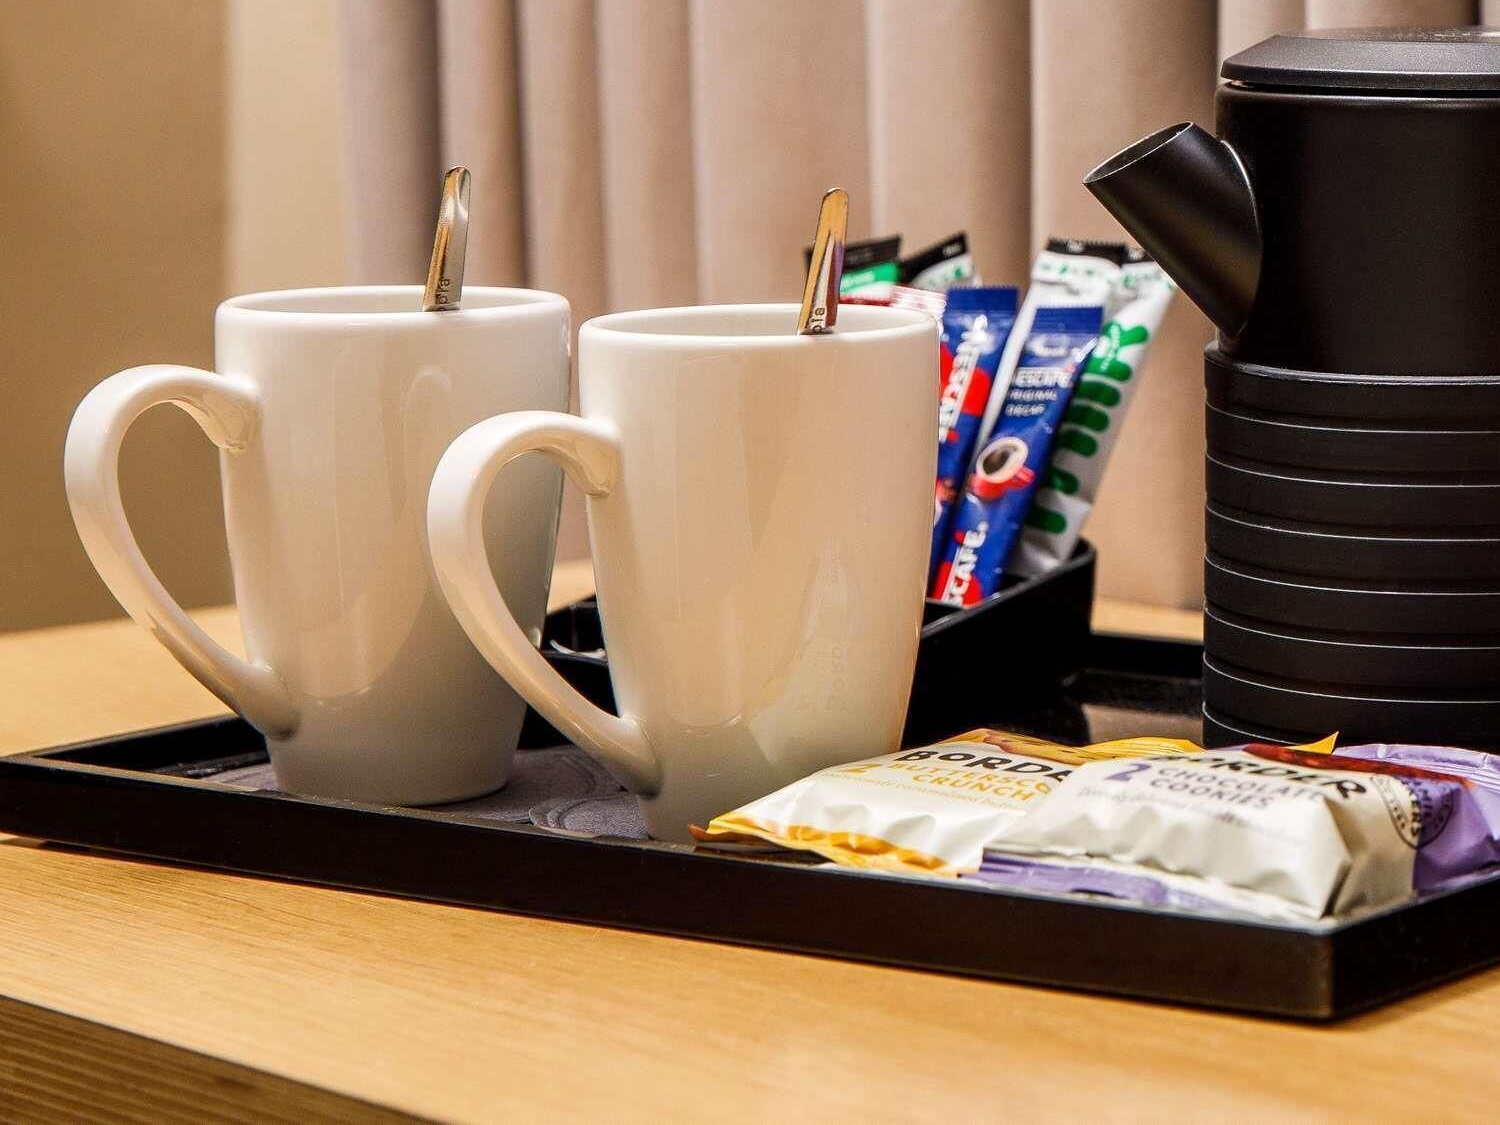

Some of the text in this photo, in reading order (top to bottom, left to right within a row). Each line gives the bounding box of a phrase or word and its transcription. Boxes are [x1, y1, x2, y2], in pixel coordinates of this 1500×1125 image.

[1103, 763, 1150, 781] 2
[911, 774, 1035, 801] CRUNCH
[1150, 778, 1277, 809] COOKIES
